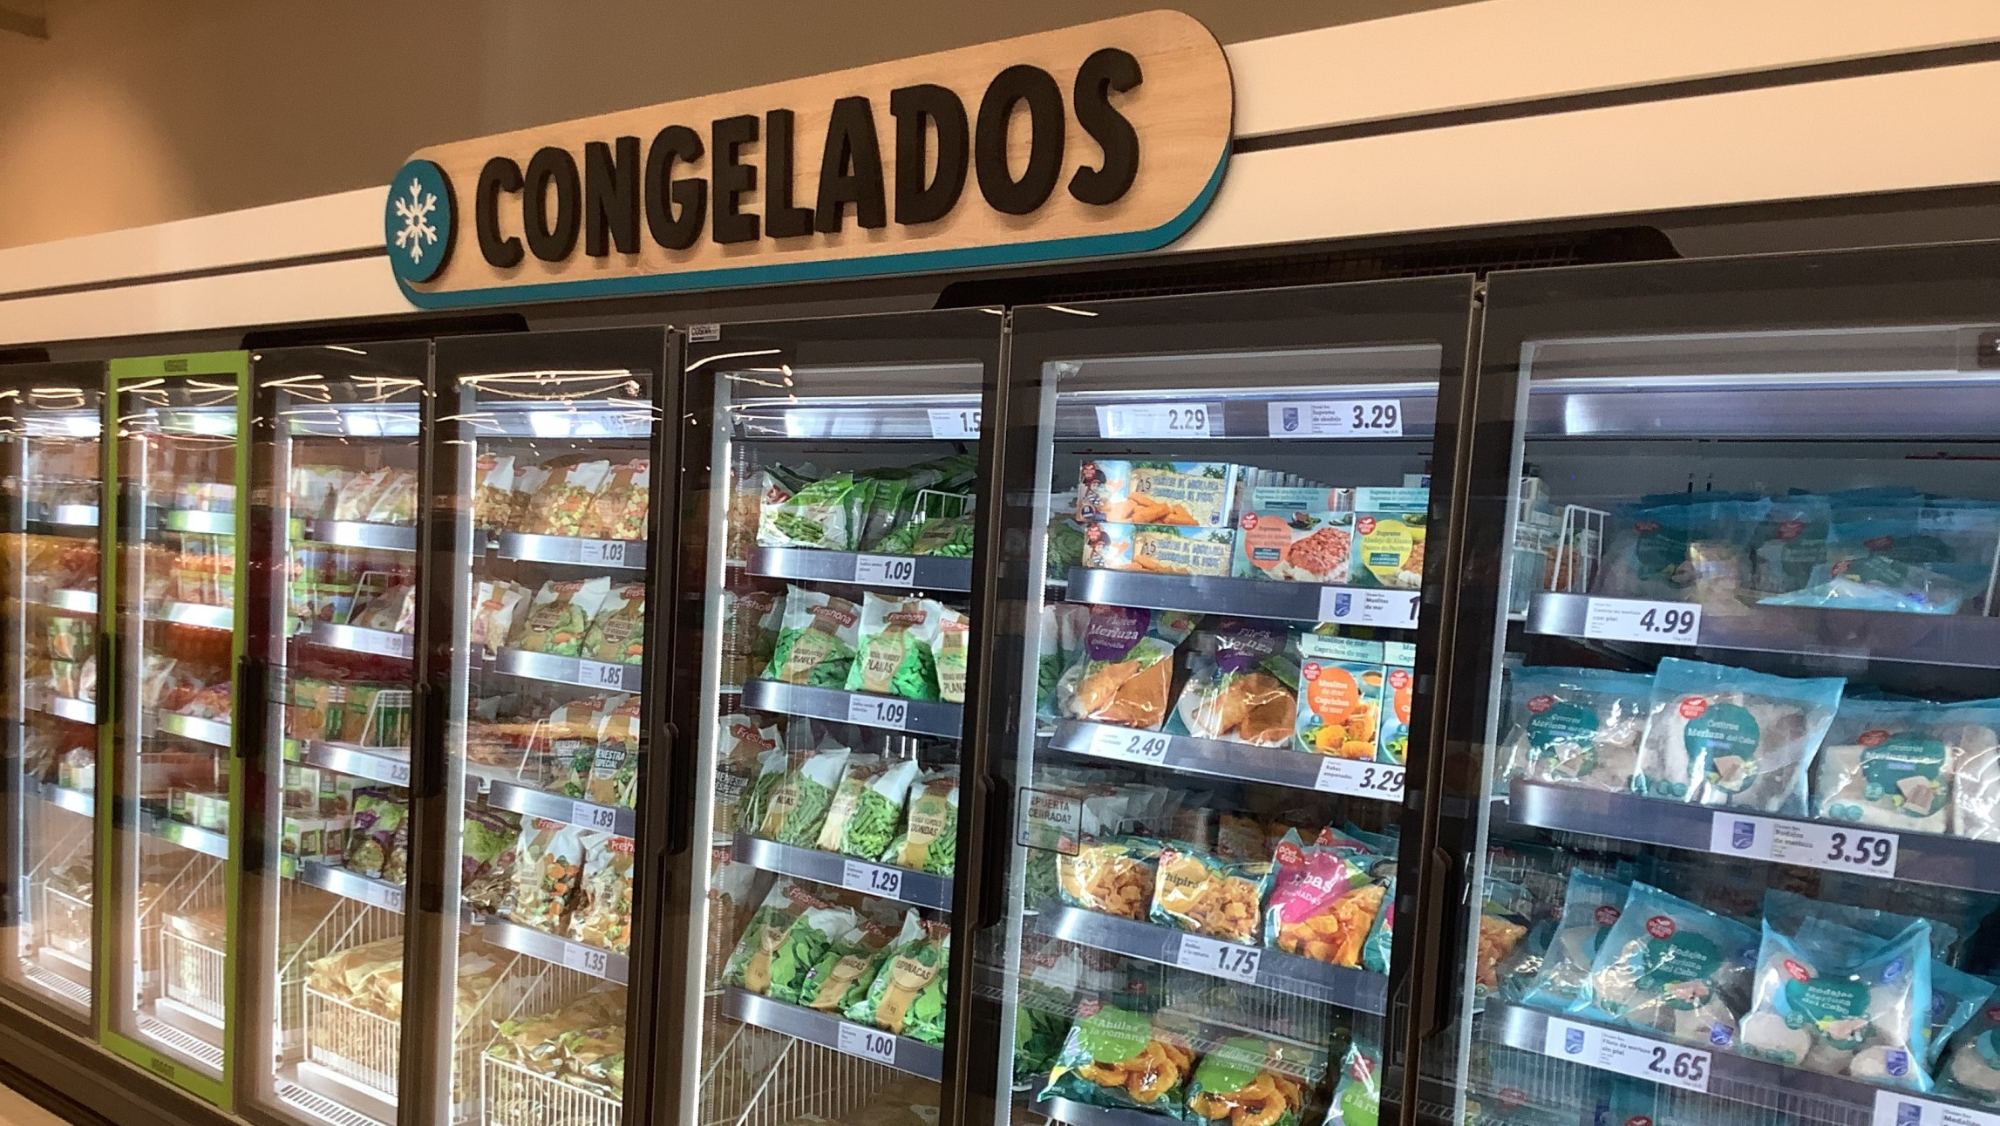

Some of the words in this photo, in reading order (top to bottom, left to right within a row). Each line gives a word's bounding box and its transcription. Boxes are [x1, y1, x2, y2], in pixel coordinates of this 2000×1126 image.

[475, 48, 1143, 268] CONGELADOS
[1169, 409, 1205, 430] 2.29
[1352, 405, 1397, 429] 3.29
[602, 543, 623, 561] 1.03
[885, 560, 912, 580] 1.09
[1640, 608, 1695, 634] 4.99
[1088, 624, 1140, 640] Merluza
[600, 666, 621, 685] 1.85
[877, 702, 904, 723] 1.09
[1688, 728, 1724, 740] Merluza
[1707, 719, 1739, 731] Centros
[1126, 735, 1166, 757] 2.49
[1359, 768, 1405, 792] 3.29
[593, 809, 614, 827] 1.89
[1828, 832, 1892, 867] 3.59
[871, 870, 899, 892] 1.29
[584, 951, 605, 971] 1.35
[1219, 946, 1258, 974] 1.75
[1805, 992, 1852, 1007] Merluza
[1808, 986, 1854, 998] Rodajas
[1821, 1002, 1850, 1015] Cabo
[1098, 1020, 1139, 1033] Anillas
[1101, 1029, 1146, 1044] romana
[866, 1034, 893, 1056] 1.00
[1649, 1046, 1707, 1081] 2.65
